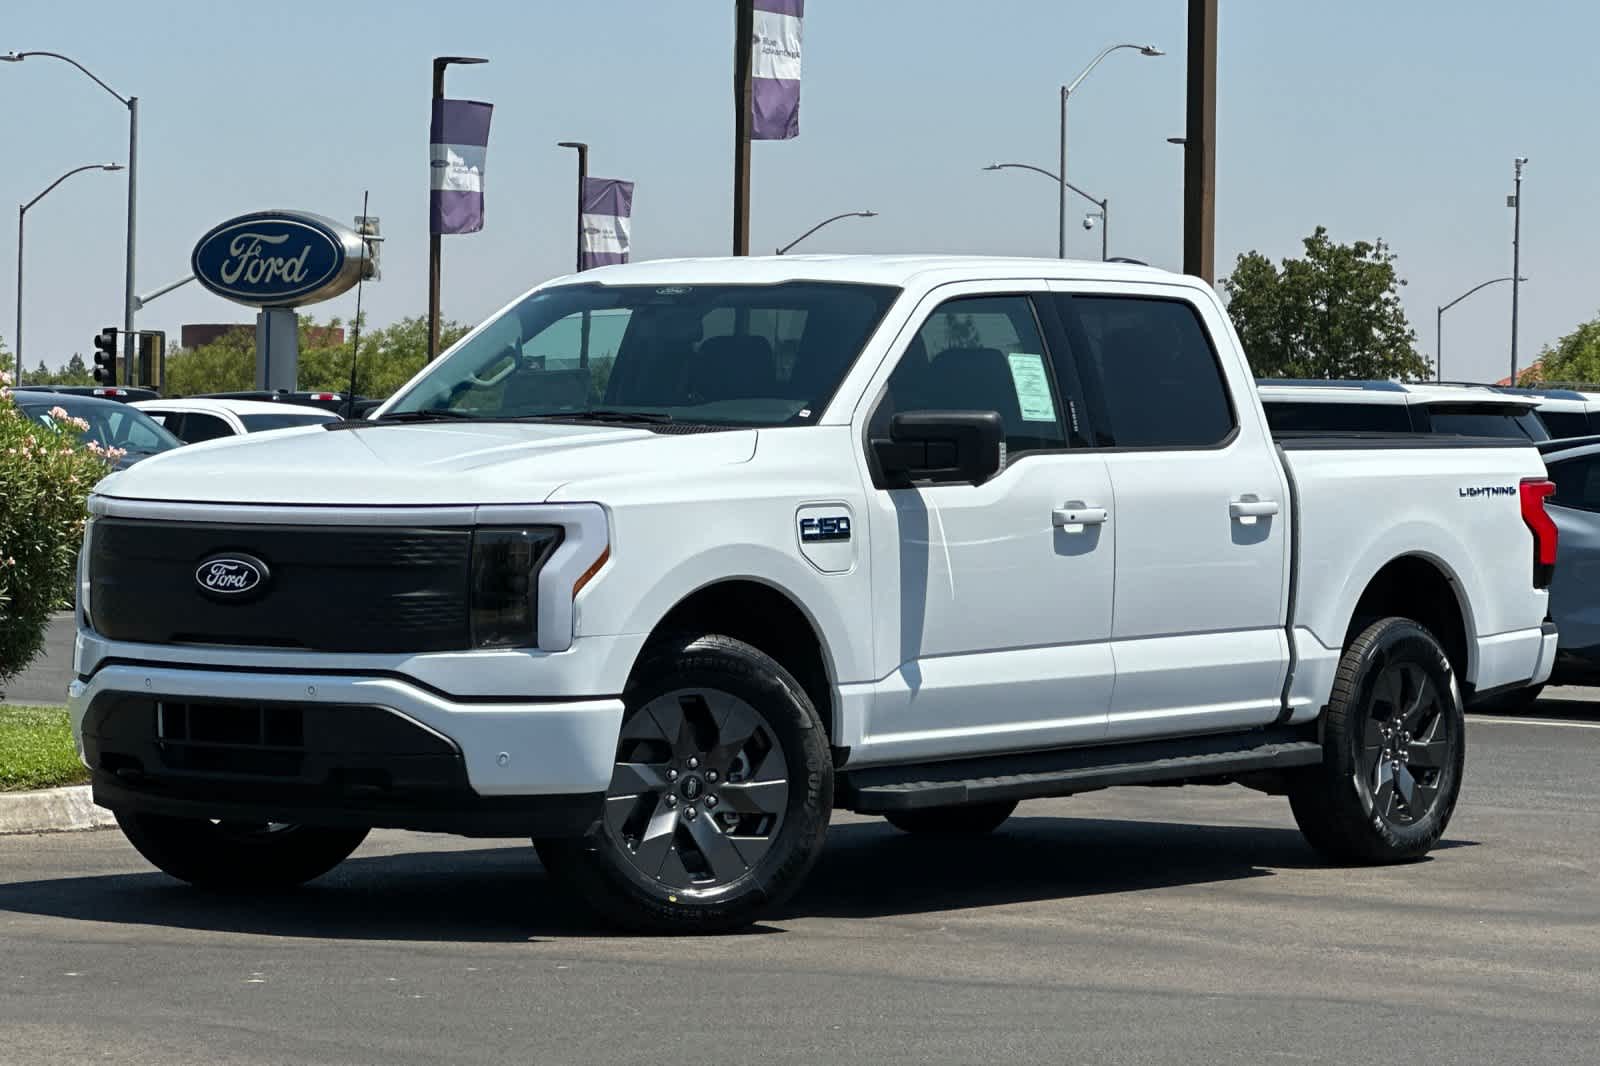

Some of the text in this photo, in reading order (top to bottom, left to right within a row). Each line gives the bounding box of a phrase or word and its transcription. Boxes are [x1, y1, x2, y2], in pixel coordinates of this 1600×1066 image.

[220, 232, 312, 285] Ford
[1459, 486, 1516, 498] LIGHTNING
[800, 516, 851, 542] F-150
[206, 563, 249, 588] Ford
